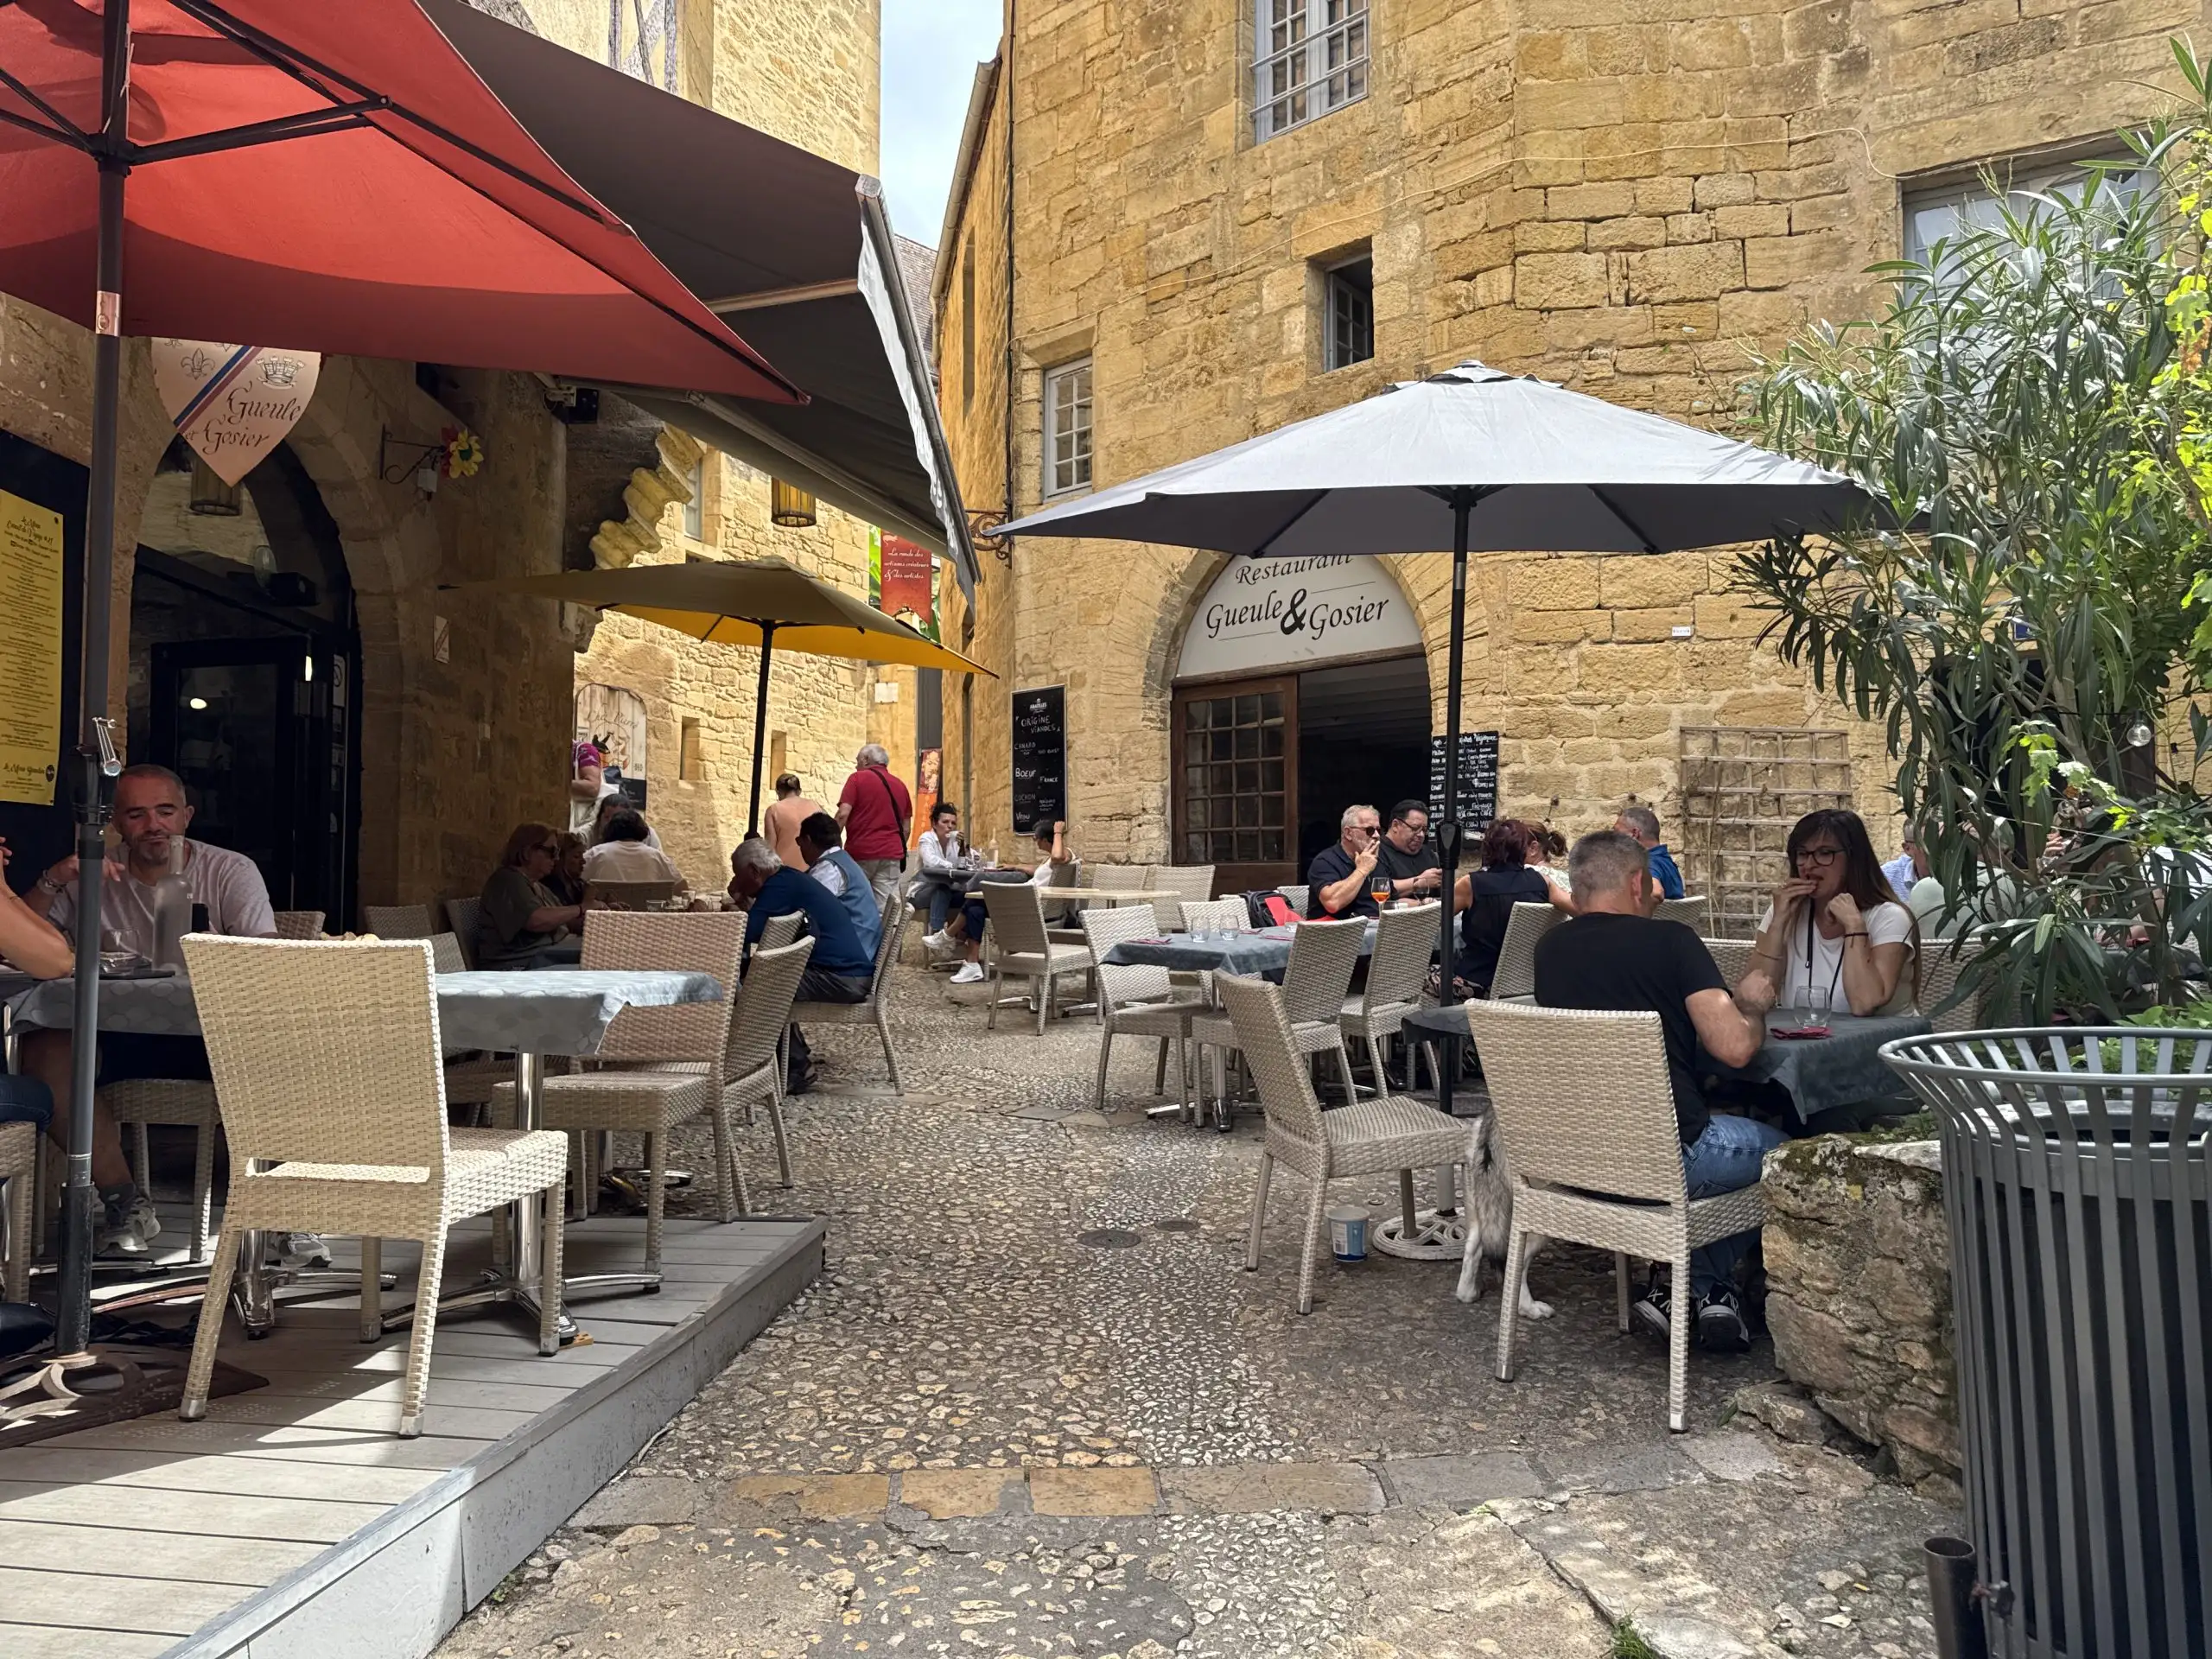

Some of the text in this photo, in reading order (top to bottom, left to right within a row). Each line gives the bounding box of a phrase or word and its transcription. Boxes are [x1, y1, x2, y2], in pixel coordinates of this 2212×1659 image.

[226, 380, 302, 425] Gueule
[202, 414, 270, 455] Gosier
[1235, 554, 1353, 586] Restaurant
[1206, 588, 1389, 641] Gueule & Gosier
